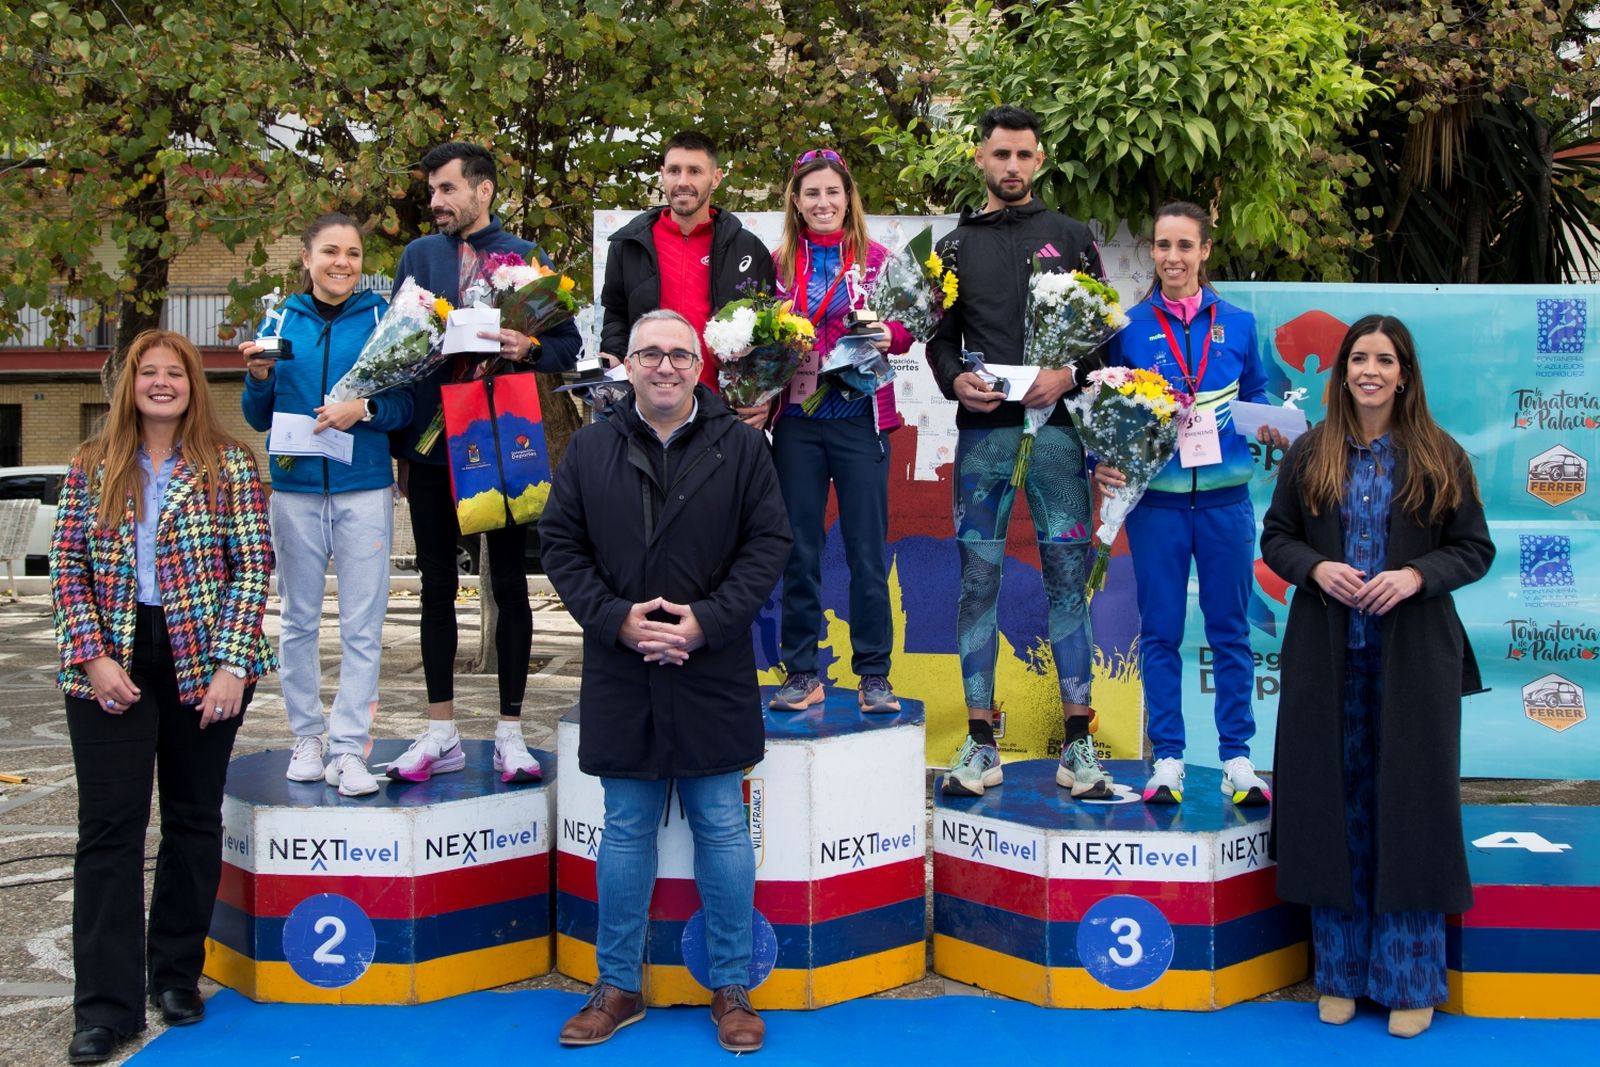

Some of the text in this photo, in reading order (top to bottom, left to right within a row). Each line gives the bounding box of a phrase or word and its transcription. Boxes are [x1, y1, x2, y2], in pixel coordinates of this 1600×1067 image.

[1511, 388, 1600, 411] Tomatería
[1531, 481, 1582, 492] FERRER
[1504, 619, 1600, 642] Tomatería
[1529, 708, 1582, 718] FERRER
[752, 789, 762, 849] VILLAFRANCA
[224, 829, 249, 856] level
[312, 915, 347, 965] 2
[1108, 917, 1144, 968] 3
